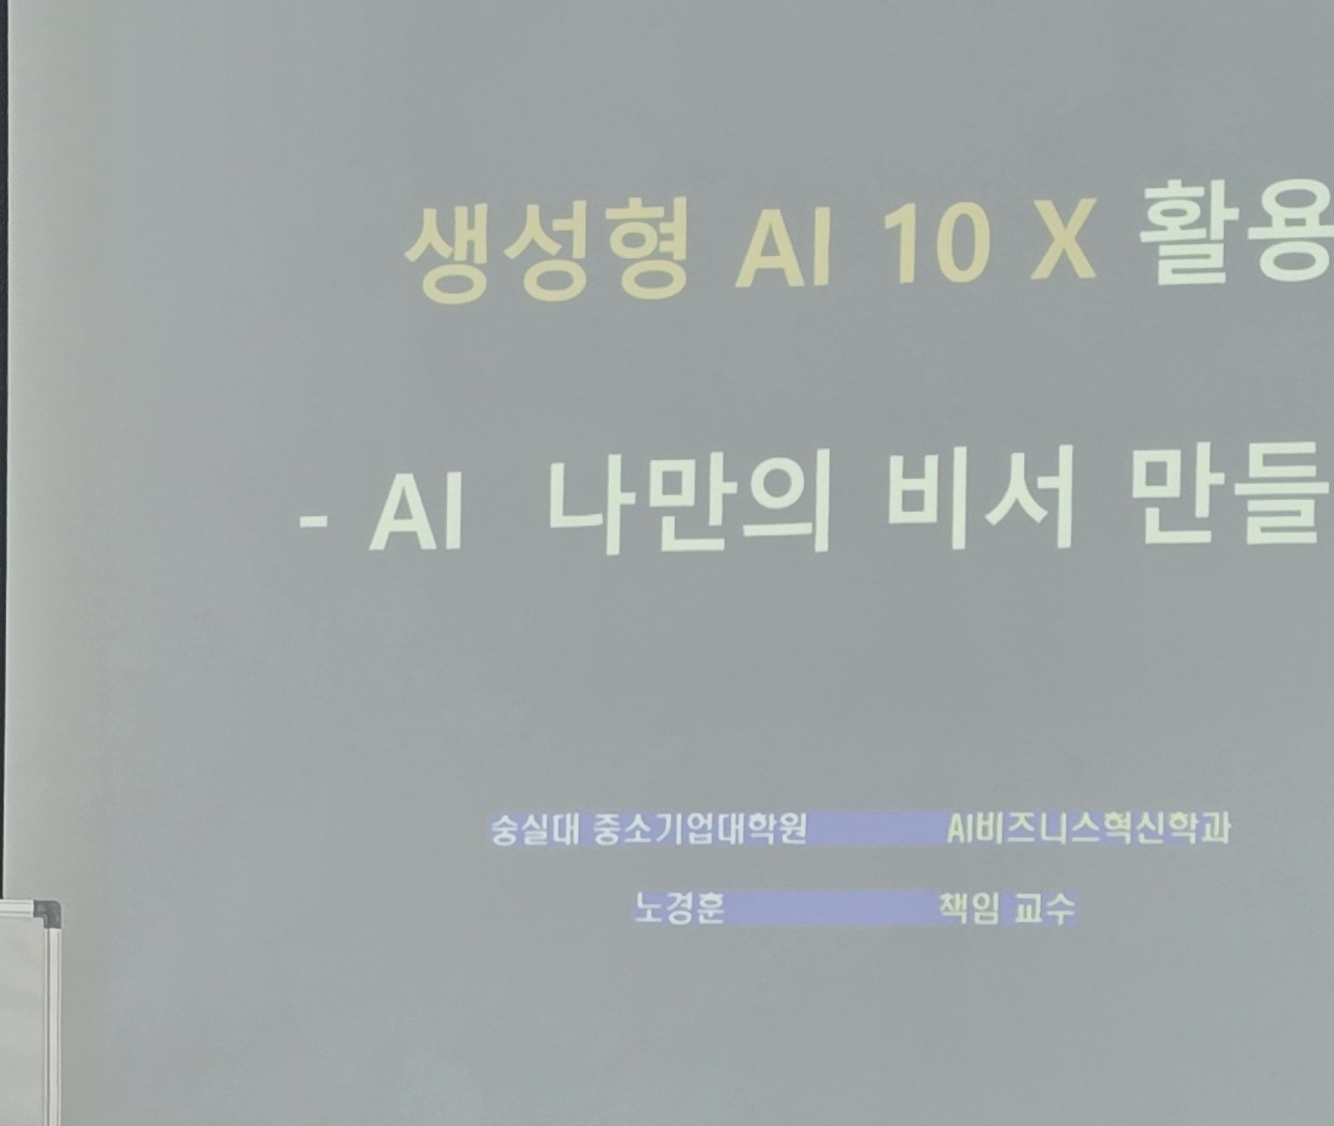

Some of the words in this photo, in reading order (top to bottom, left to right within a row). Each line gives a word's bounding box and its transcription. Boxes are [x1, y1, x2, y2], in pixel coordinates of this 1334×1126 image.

[405, 196, 689, 306] 생성형
[735, 206, 833, 289] AI
[884, 201, 992, 285] 10
[1030, 198, 1099, 281] X
[369, 471, 463, 552] AI
[549, 447, 832, 557] 나만의
[888, 444, 1075, 552] 비서
[491, 812, 581, 847] 숭실대
[592, 812, 808, 846] 중소기업대학원
[946, 811, 1233, 846] AI비즈니스혁신학과
[634, 891, 725, 926] 노경훈
[939, 892, 1000, 926] 책임
[1014, 892, 1076, 926] 교수
